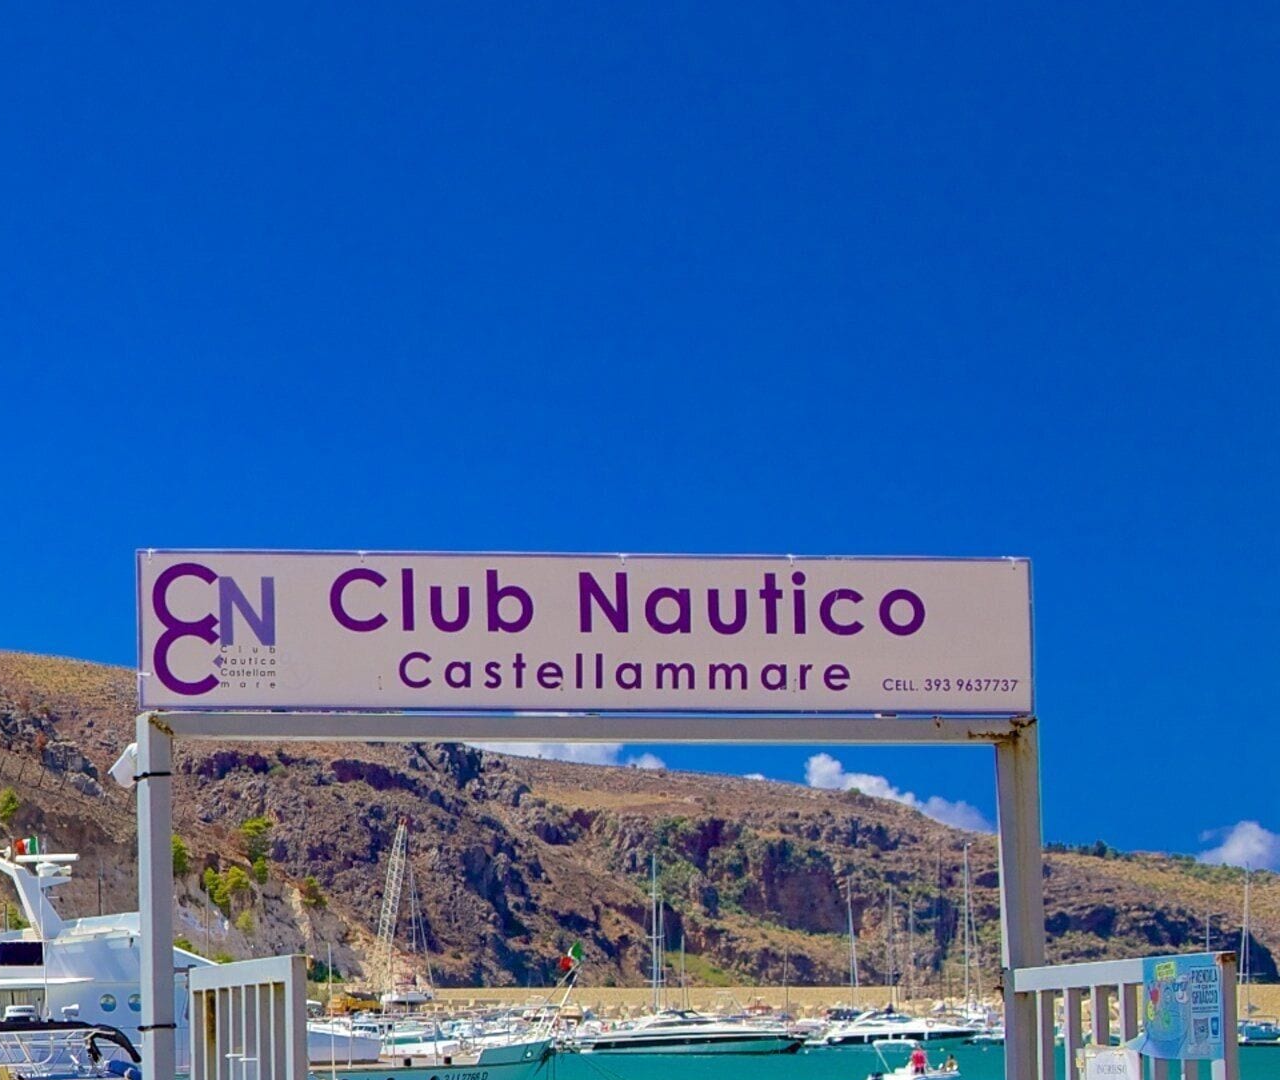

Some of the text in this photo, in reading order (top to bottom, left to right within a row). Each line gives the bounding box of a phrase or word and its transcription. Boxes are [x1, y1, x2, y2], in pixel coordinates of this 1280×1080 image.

[329, 567, 927, 637] Club Nautico
[220, 646, 275, 654] Club
[220, 657, 276, 665] Nautico
[220, 668, 276, 677] Castellam
[397, 650, 851, 692] Castellammare
[220, 681, 276, 689] mare
[882, 678, 1019, 692] CELL. 393 9637737
